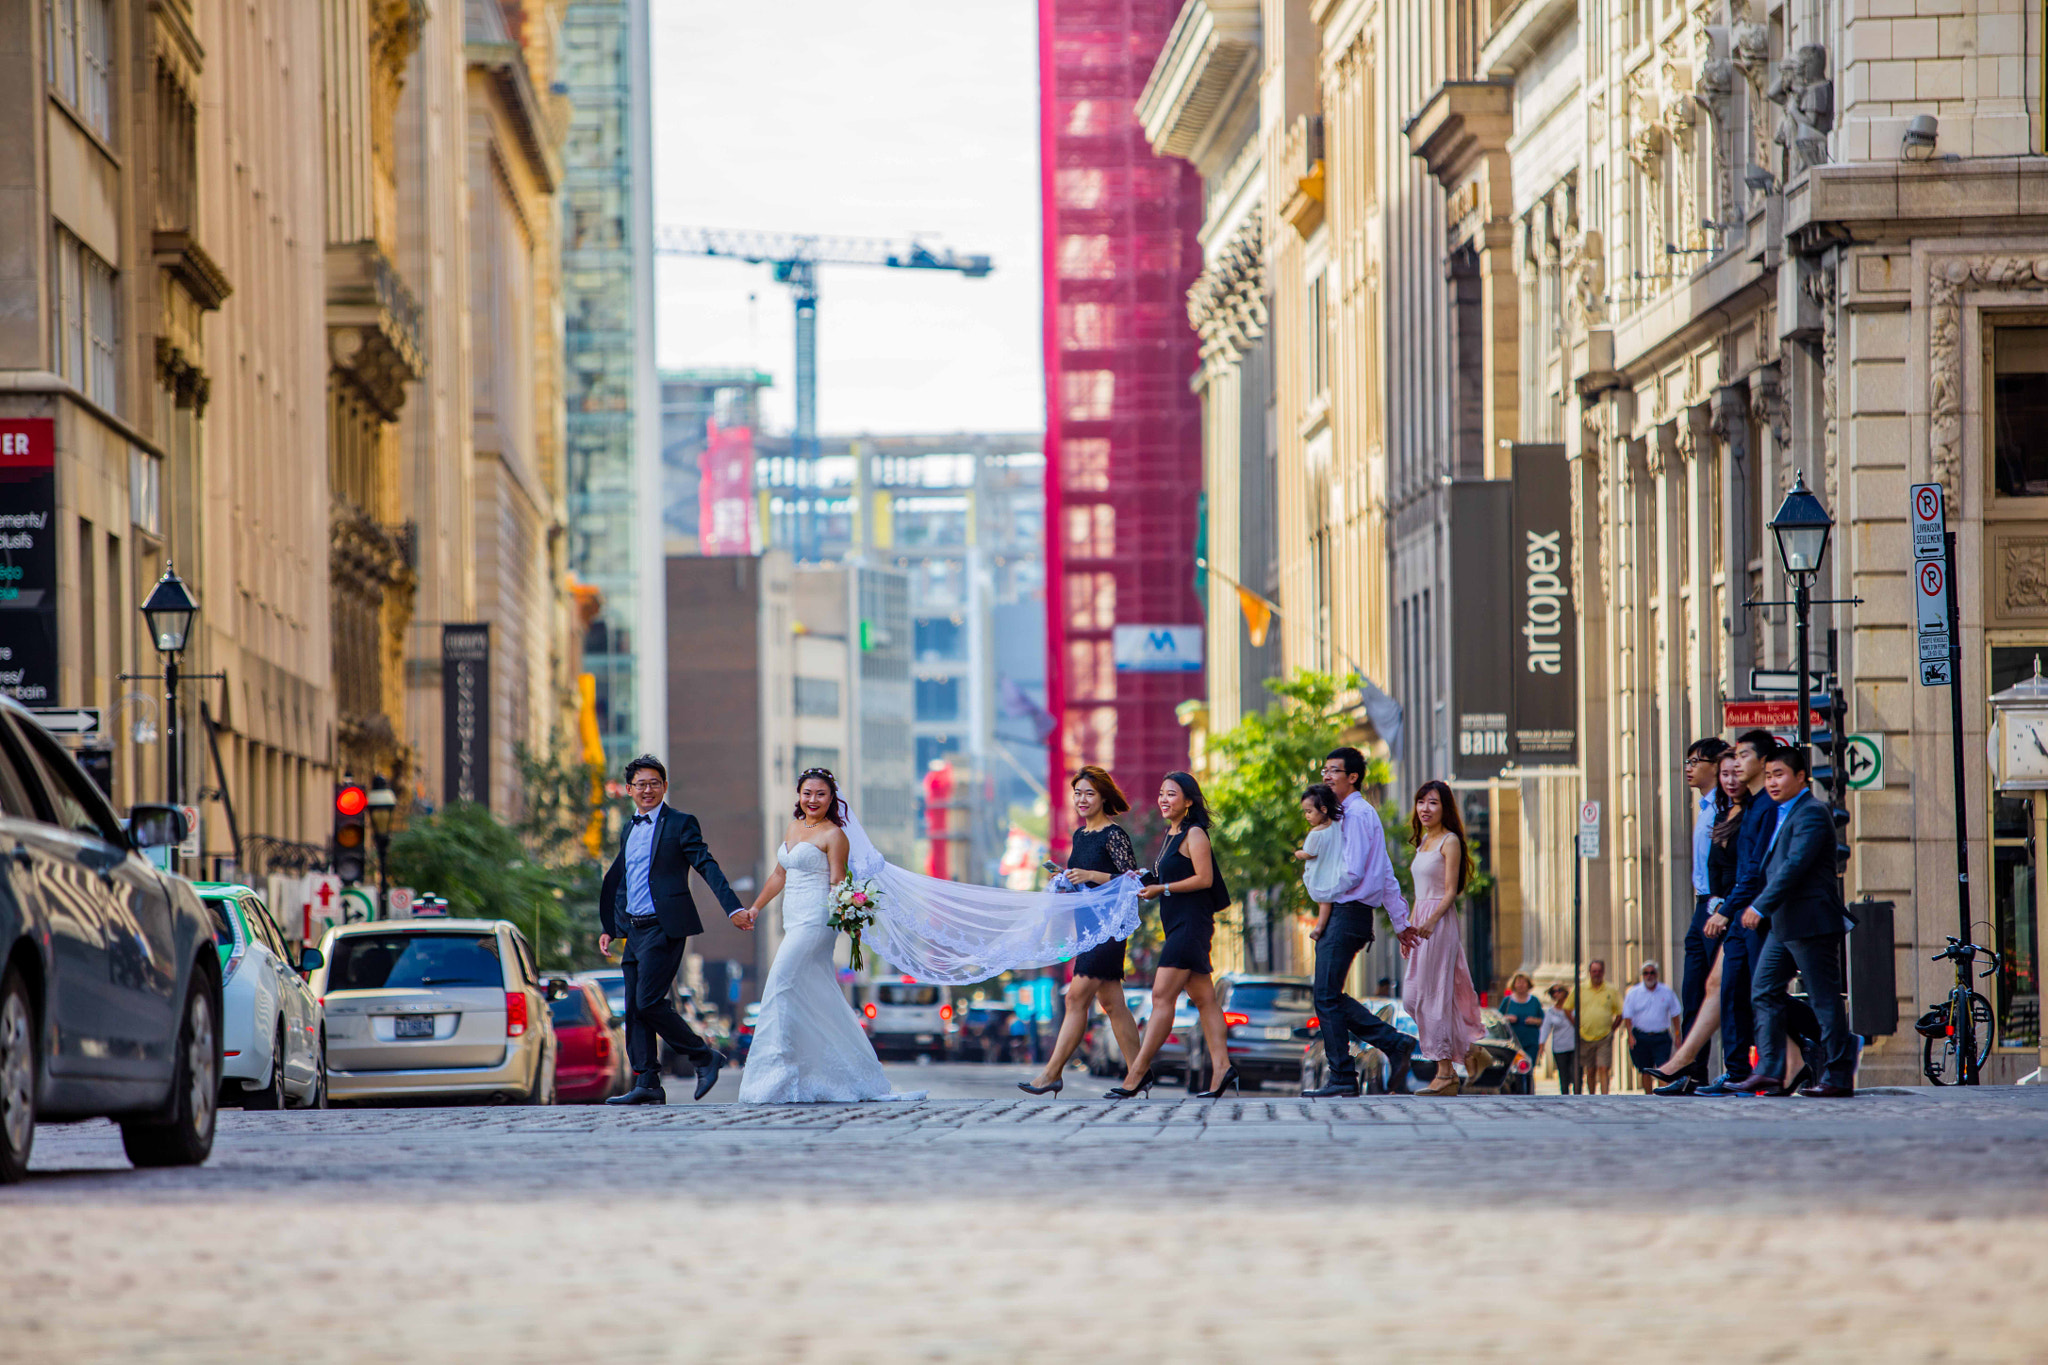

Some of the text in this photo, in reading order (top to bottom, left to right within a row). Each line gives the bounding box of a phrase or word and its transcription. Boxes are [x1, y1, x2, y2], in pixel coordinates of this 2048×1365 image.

[0, 432, 30, 455] ER
[1916, 523, 1941, 533] LIVRAISON
[1916, 534, 1942, 544] SEULEMENT
[1521, 529, 1568, 674] artopex
